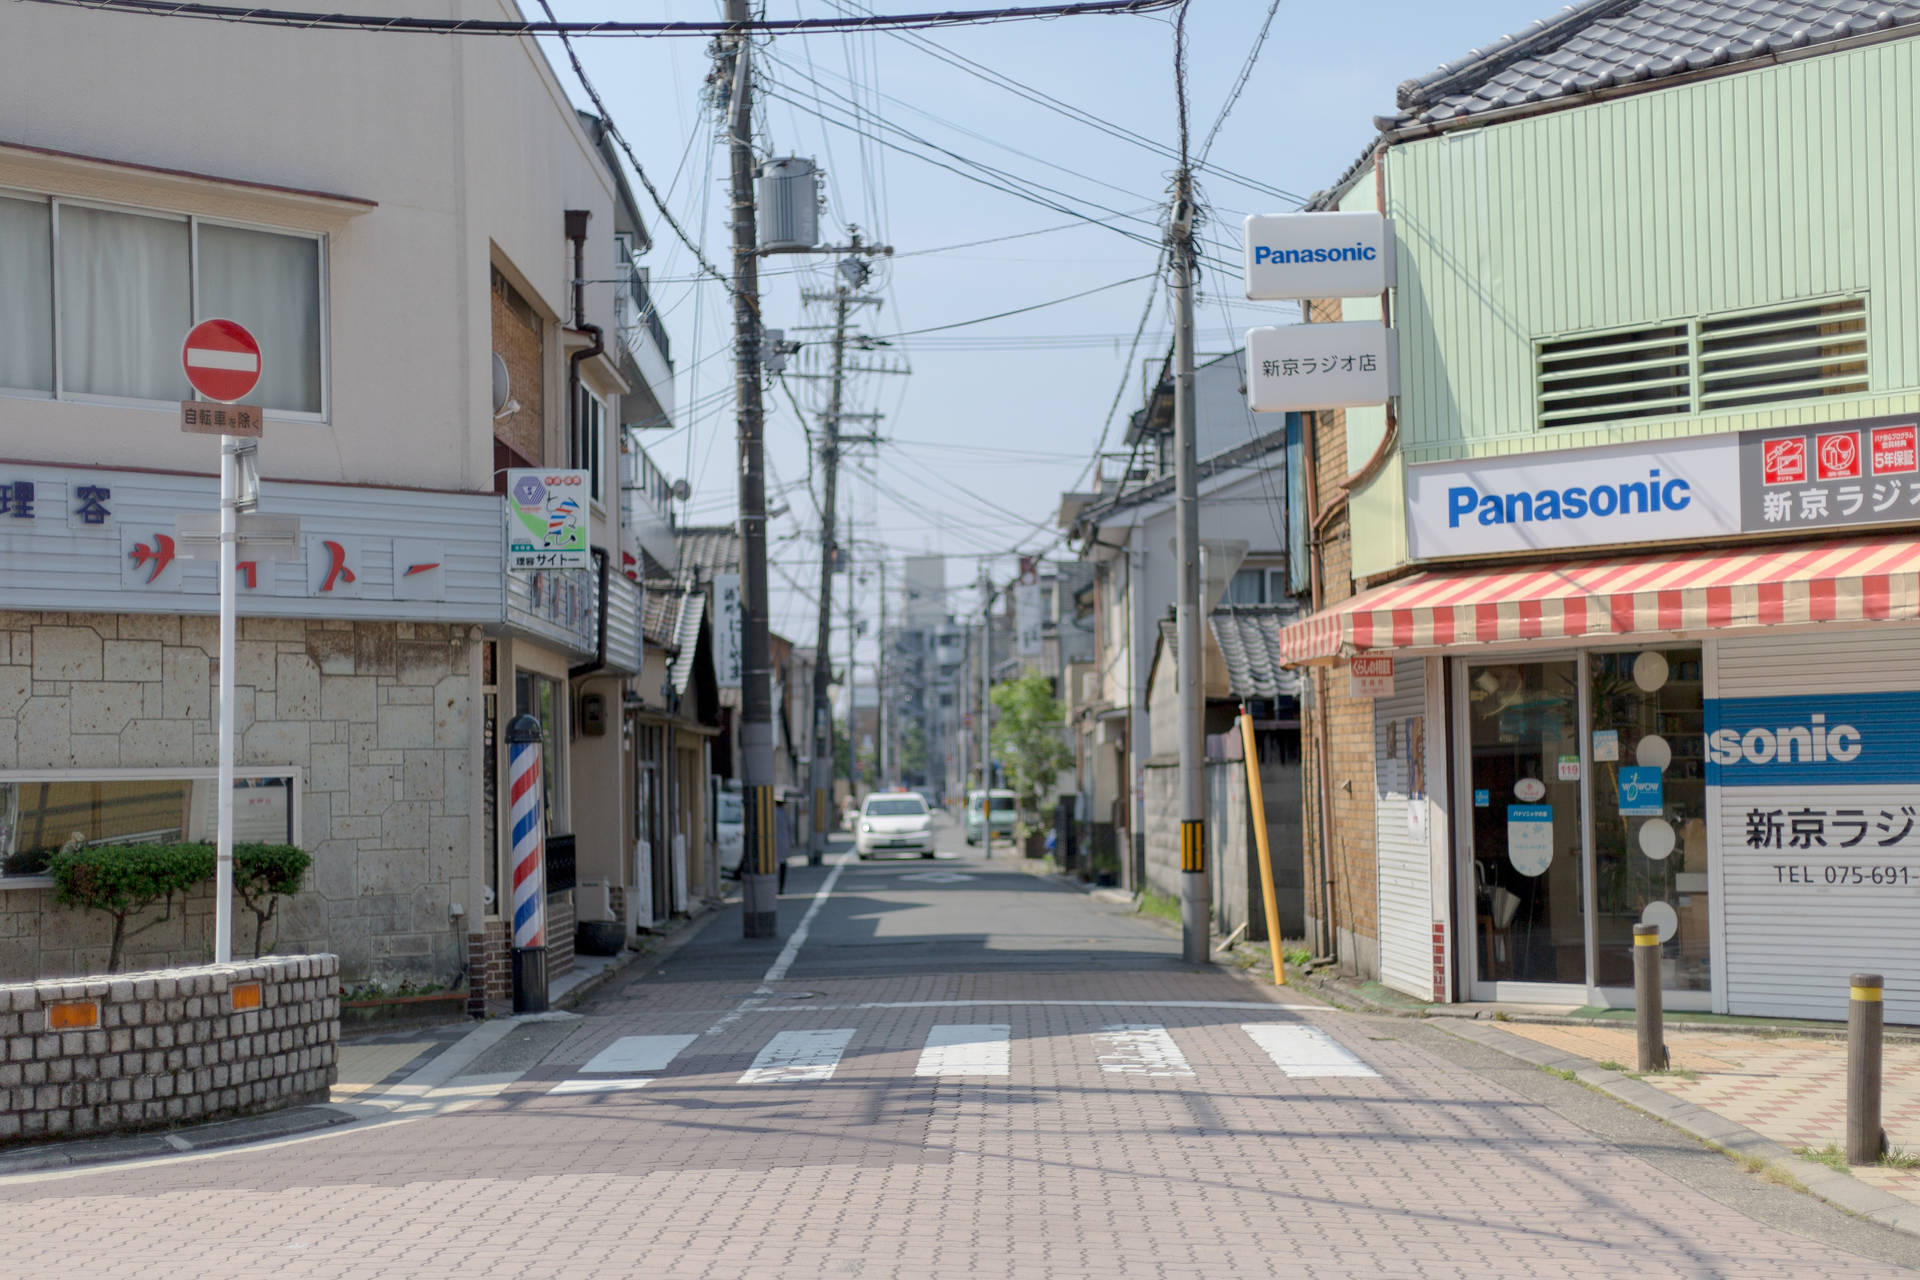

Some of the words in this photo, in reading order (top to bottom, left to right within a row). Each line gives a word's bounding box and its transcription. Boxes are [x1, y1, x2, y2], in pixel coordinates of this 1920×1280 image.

[1255, 242, 1377, 264] Panasonic
[1262, 354, 1377, 377] 新京ラジオ店
[185, 408, 260, 430] 自転車を除く
[1875, 449, 1914, 469] 5年保証
[1448, 469, 1691, 528] Panasonic
[1561, 765, 1578, 776] 119
[1746, 806, 1916, 849] 新京ラジ
[1773, 865, 1814, 884] TEL
